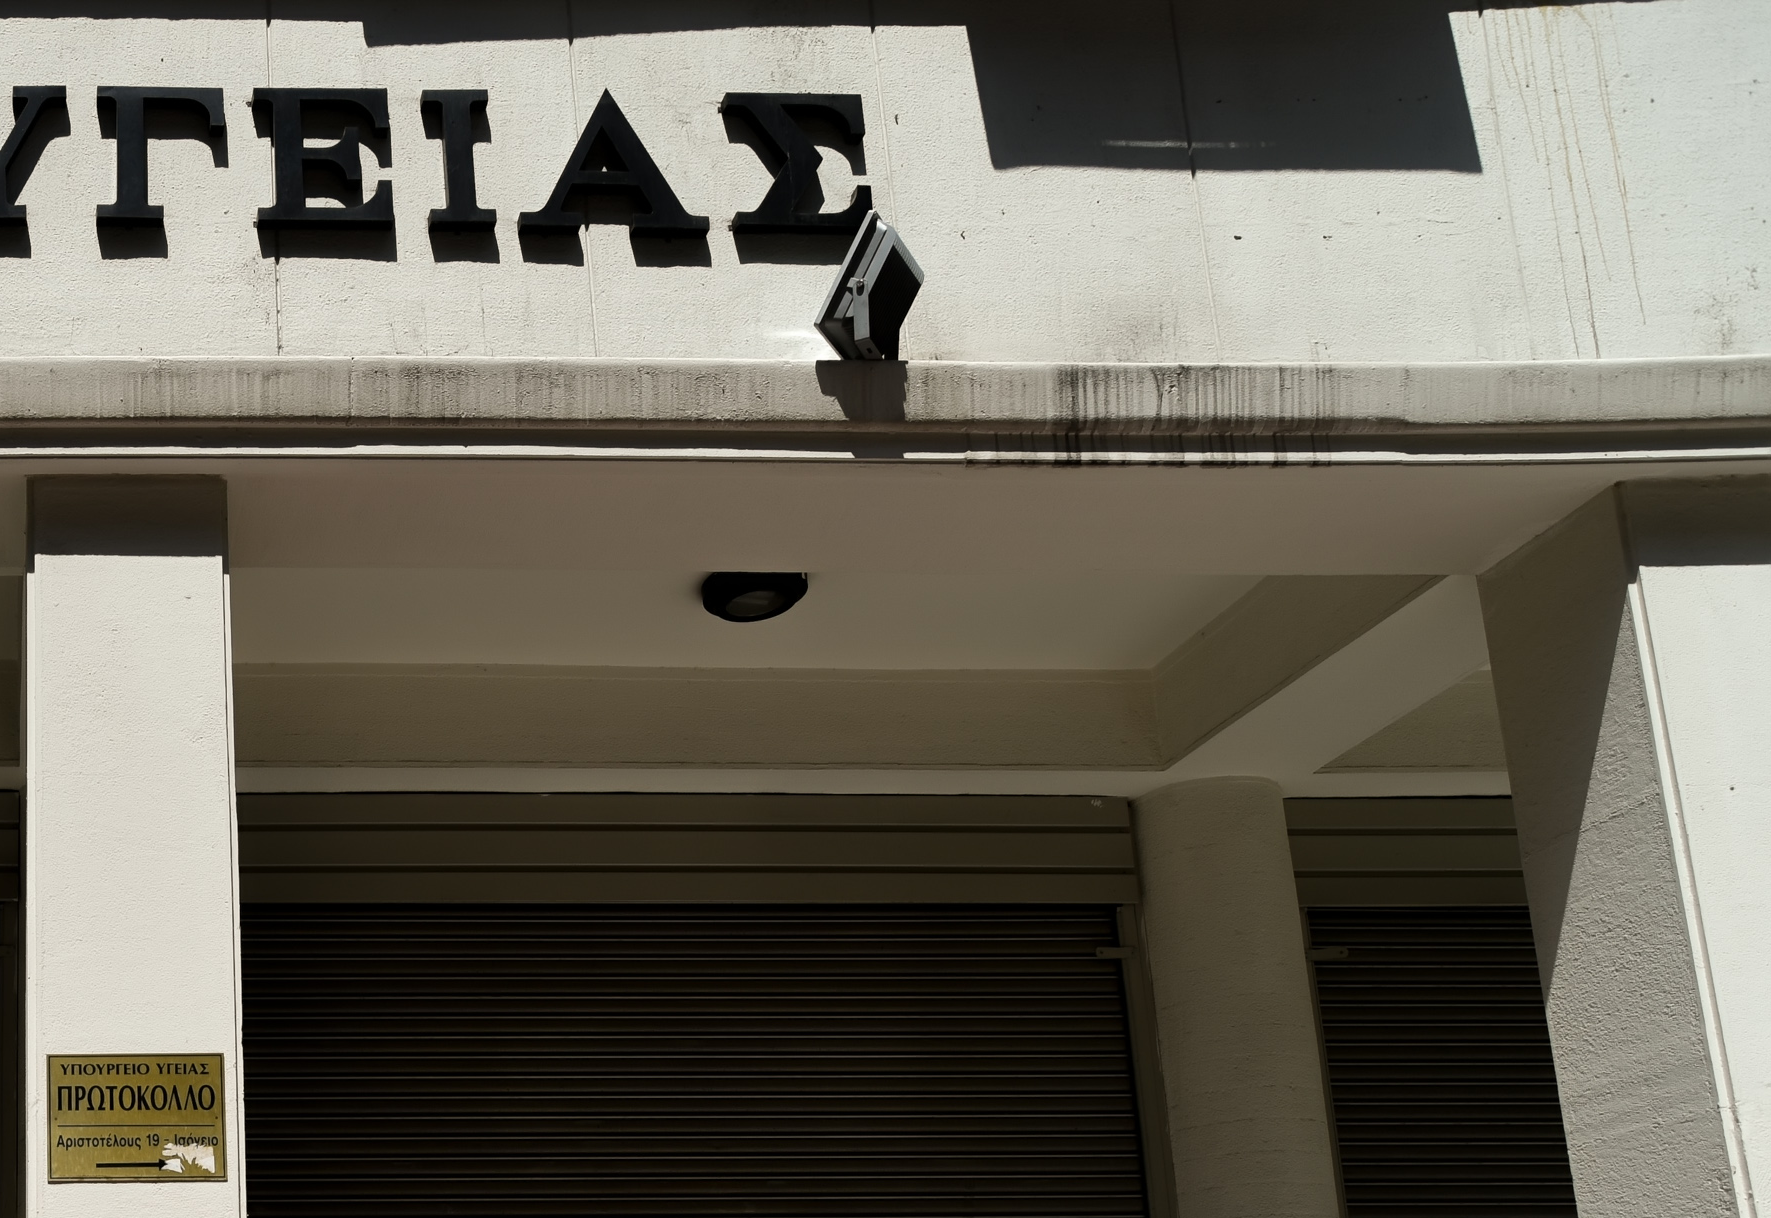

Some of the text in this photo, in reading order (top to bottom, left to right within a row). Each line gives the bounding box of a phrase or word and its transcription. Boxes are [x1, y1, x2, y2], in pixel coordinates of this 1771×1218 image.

[60, 1063, 210, 1076] ΥΠΟΥΡΓΕΙΟ ΥΓΕΙΑΣ
[57, 1084, 216, 1111] ΠΡΩΤΟΚΟΛΛΟ
[56, 1133, 141, 1151] Αριστοτέλους
[146, 1133, 160, 1147] 19
[174, 1132, 219, 1149] Ισόγειο
